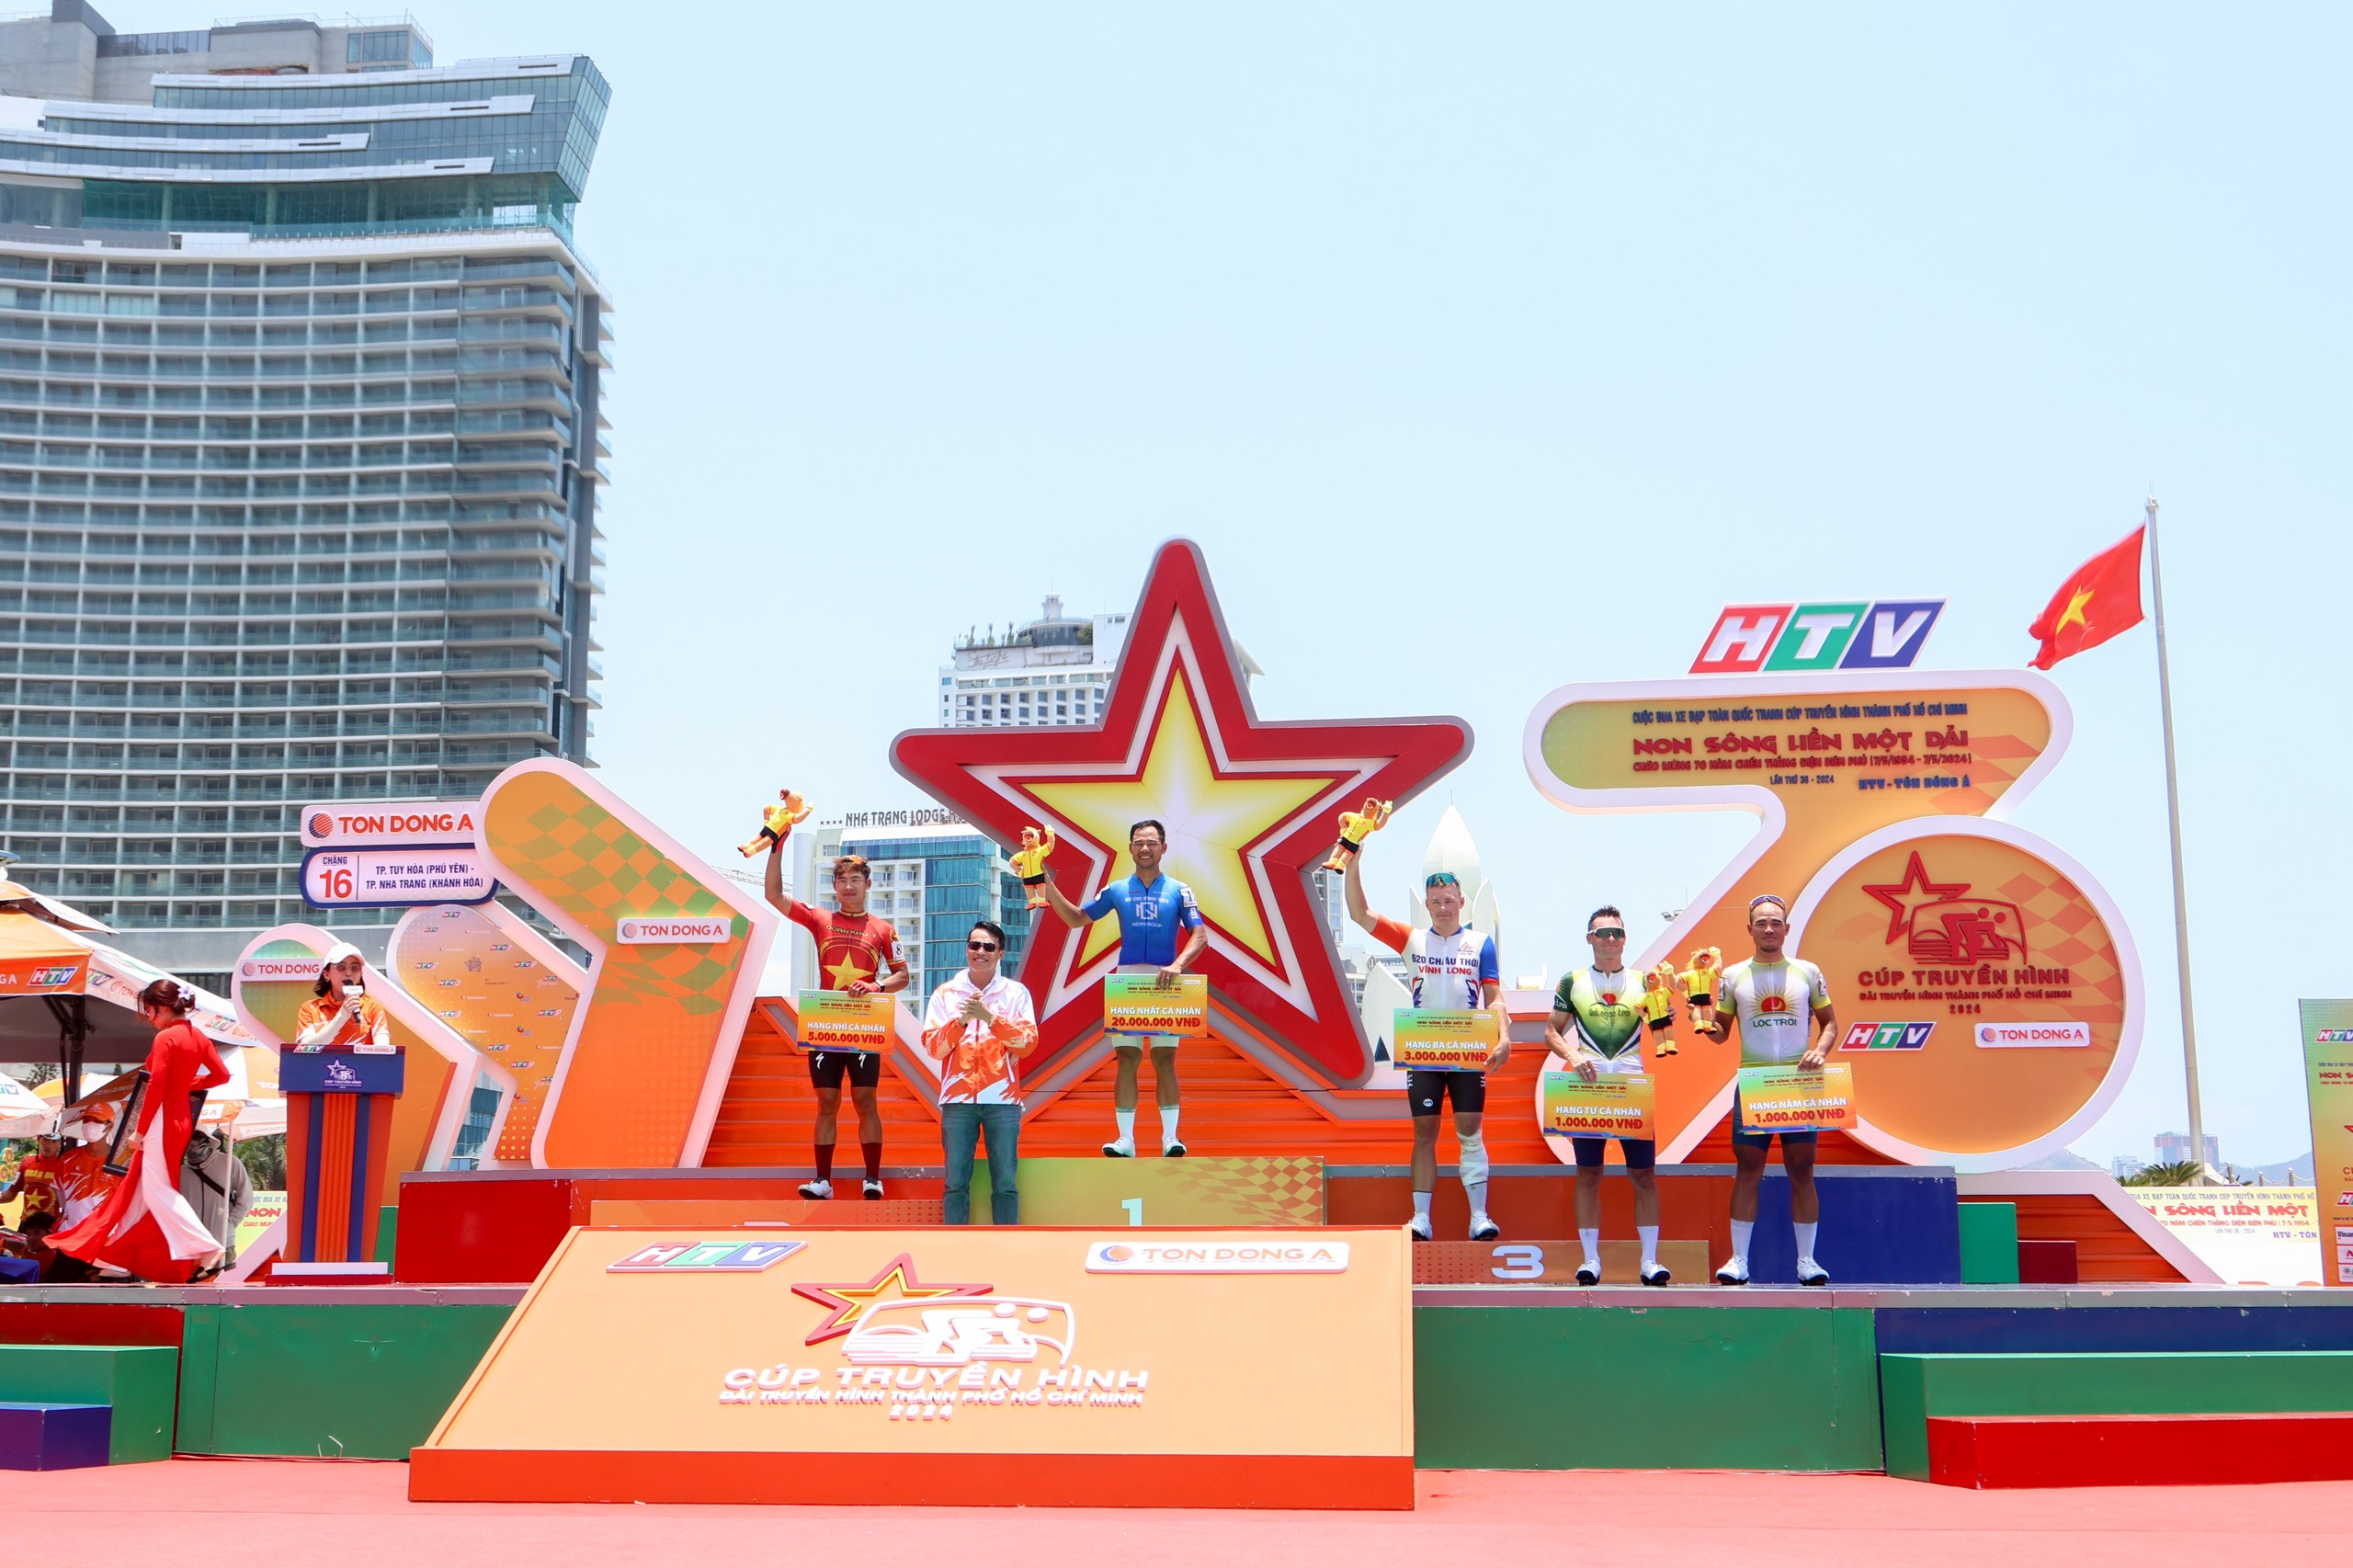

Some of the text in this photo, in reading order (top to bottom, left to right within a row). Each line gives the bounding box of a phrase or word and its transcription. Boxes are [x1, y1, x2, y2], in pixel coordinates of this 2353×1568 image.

[1701, 609, 1933, 663] HTV
[1632, 710, 1654, 725] CUỘC
[1676, 710, 1687, 722] XE
[1708, 708, 1729, 722] TOÀN
[1732, 706, 1754, 722] QUỐC
[1756, 708, 1783, 722] TRANH
[1786, 706, 1802, 720] CÚP
[1839, 704, 1860, 719] HÌNH
[1862, 703, 1892, 718] THÀNH
[1893, 702, 1911, 717] PHỐ
[1927, 702, 1942, 717] CHÍ
[1945, 703, 1968, 716] MINH
[1632, 724, 1969, 756] NON SÔNG LIỀN MỘT DẢI
[1694, 760, 1707, 770] 70
[1800, 775, 1809, 784] 36
[1816, 775, 1835, 783] 2024
[1859, 778, 1886, 790] HTV
[1894, 776, 1920, 790] TÔN
[1961, 774, 1971, 788] Á
[338, 813, 474, 835] TON DONG A
[846, 812, 869, 827] NHA
[871, 810, 907, 827] TRANG
[910, 809, 945, 826] LODGE
[323, 856, 348, 867] CHẶNG
[375, 862, 469, 875] TP. TUY HÒA (PHÚ YÊN)
[319, 869, 352, 899] 16
[366, 877, 483, 890] TP. NHA TRANG (KHÁNH HÒA)
[641, 925, 723, 936] TON DONG A
[1411, 954, 1426, 964] 620
[258, 963, 320, 974] TON DONG
[1447, 967, 1472, 975] LONG
[1858, 963, 2070, 986] CÚP TRUYỀN HÌNH
[31, 970, 74, 984] HTV
[1859, 990, 1877, 1001] ĐÀI
[1880, 988, 1915, 1001] TRUYỀN
[1918, 990, 1943, 1001] HÌNH
[1945, 990, 1979, 1000] THÀNH
[1982, 988, 2003, 1000] PHỐ
[2024, 989, 2042, 999] CHÍ
[2045, 990, 2072, 999] MINH
[1110, 1005, 1201, 1017] HẠNG NHẤT CÁ NHÂN
[1949, 1004, 1982, 1015] 2024
[807, 1021, 886, 1033] HẠNG NHÌ CÁ NHÂN
[1111, 1017, 1200, 1028] 20.000.000 VNĐ
[808, 1031, 885, 1044] 5.000.000 VNĐ
[1847, 1027, 1928, 1045] HTV
[1999, 1028, 2084, 1040] TON DONG A
[1405, 1040, 1487, 1051] HẠNG BA CÁ NHÂN
[1404, 1051, 1488, 1062] 3.000.000 VNĐ
[1749, 1096, 1847, 1112] HẠNG NĂM CÁ NHÂN
[1556, 1106, 1642, 1117] HẠNG TƯ CÁ NHÂN
[1755, 1108, 1846, 1123] 1.000.000 VNĐ
[1555, 1117, 1643, 1130] 1.000.000 VNĐ
[245, 1208, 281, 1217] NON
[1121, 1198, 1142, 1226] 1
[2164, 1199, 2308, 1218] SÔNG LIỀN MỘT
[1142, 1248, 1333, 1262] TON DONG A
[1491, 1244, 1545, 1279] 3
[724, 1361, 1149, 1392] CÚP TRUYỀN HÌNH
[719, 1388, 755, 1404] ĐÀI
[759, 1386, 831, 1404] TRUYỀN
[835, 1387, 884, 1404] HÌNH
[890, 1388, 957, 1405] THÀNH
[961, 1387, 1009, 1405] PHỐ
[1047, 1390, 1089, 1407] CHÍ
[1089, 1392, 1142, 1407] MINH
[890, 1404, 953, 1421] 2024
